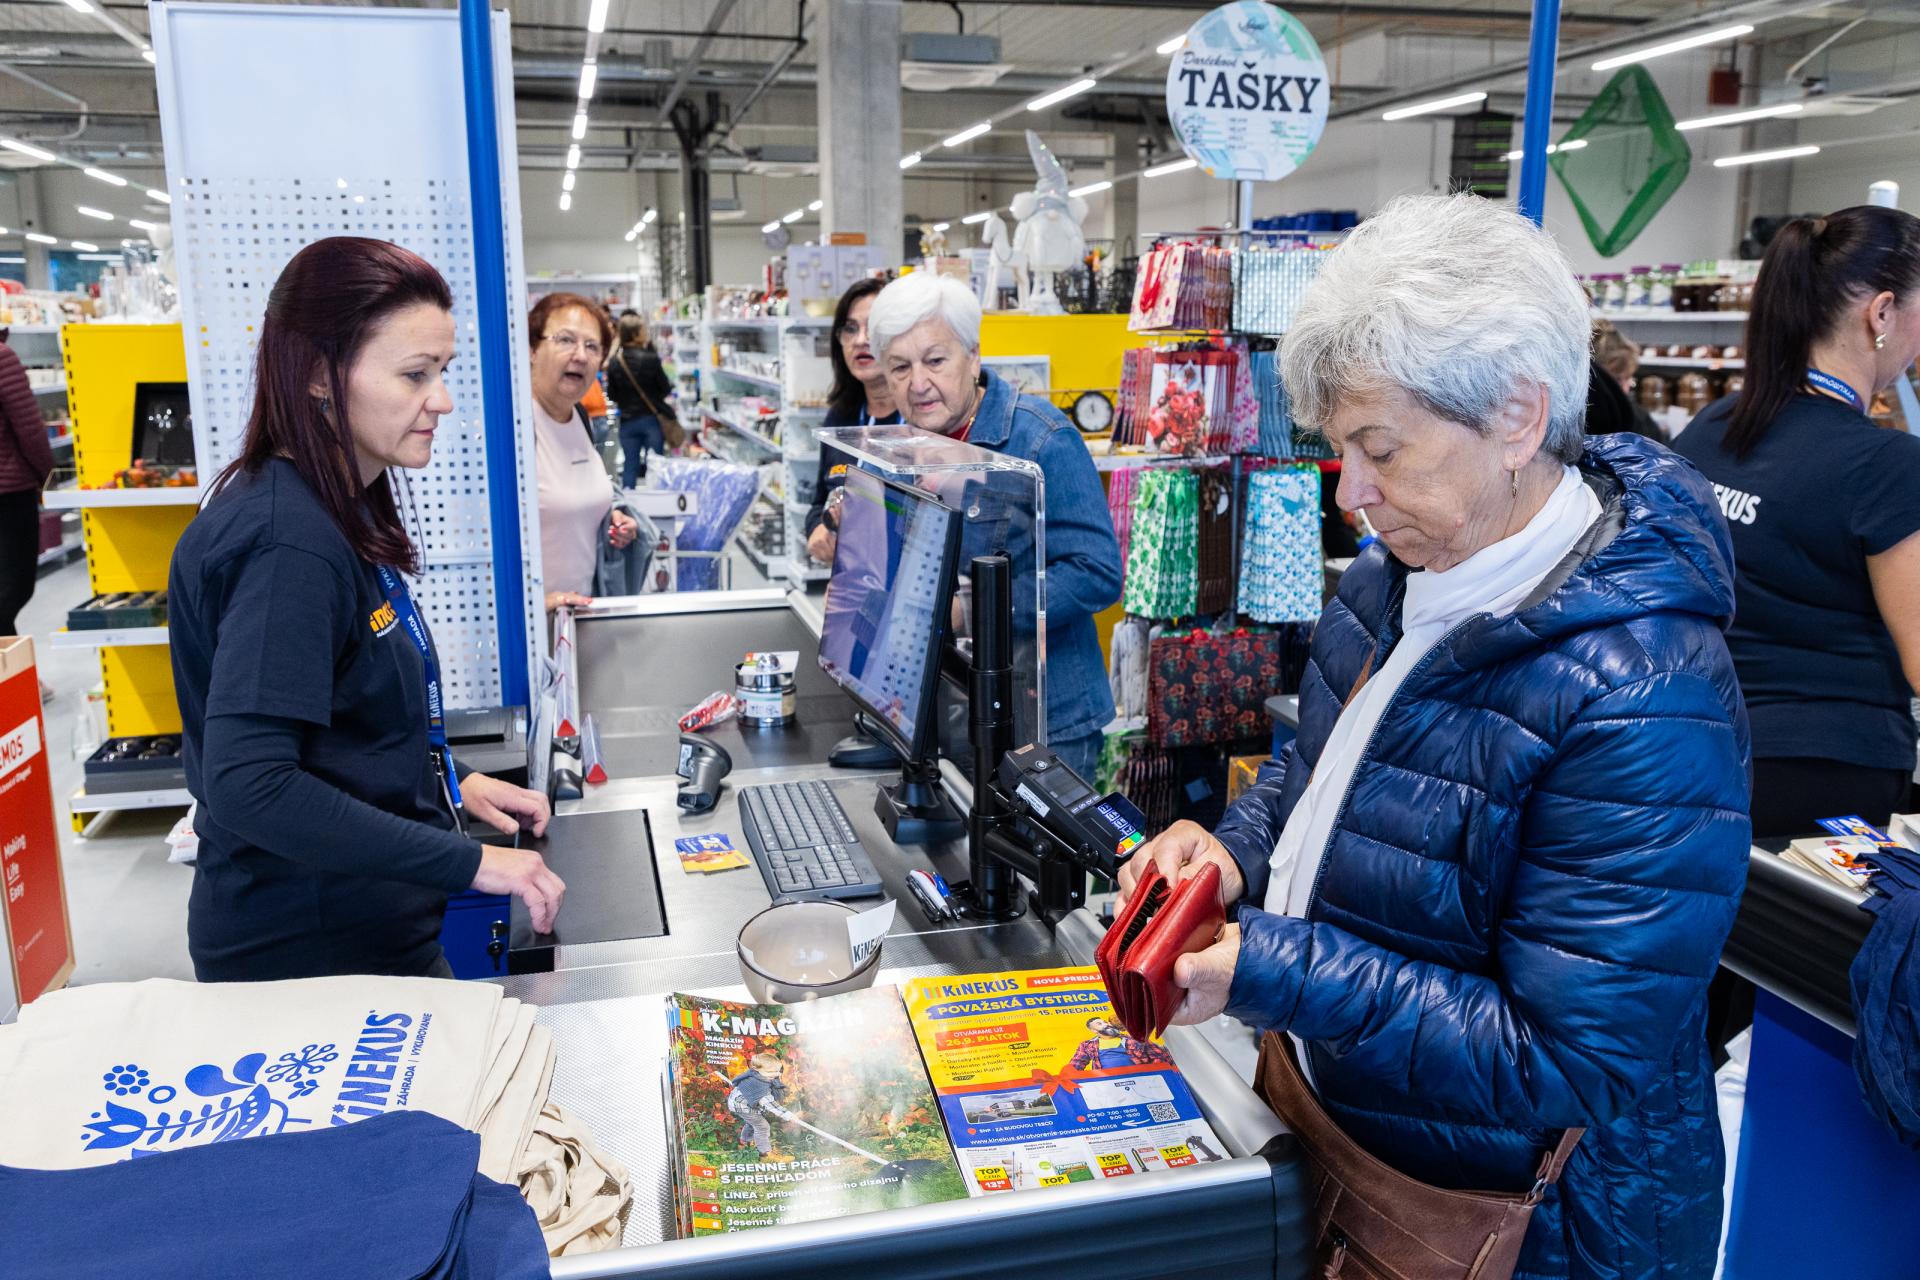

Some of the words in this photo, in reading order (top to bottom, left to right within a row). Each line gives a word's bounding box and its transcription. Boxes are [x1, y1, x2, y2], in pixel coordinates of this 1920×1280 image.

[1180, 61, 1321, 113] TAŠKY
[0, 735, 24, 770] MOS
[944, 978, 1019, 997] KiNEKUS
[1033, 977, 1062, 985] NOVÁ
[1063, 974, 1103, 982] PREDAJ
[938, 996, 1021, 1016] POVAŽSKÁ
[1025, 993, 1100, 1006] BYSTRICA
[1055, 1005, 1110, 1015] PREDAJNE
[411, 1013, 432, 1056] VYKUROVANIE
[946, 1036, 975, 1047] 26.9.
[977, 1031, 1021, 1042] PIATOK
[397, 1065, 416, 1106] ZÁHRADA
[1100, 1154, 1121, 1162] TOP
[1163, 1146, 1184, 1154] TOP
[702, 1169, 713, 1177] 12
[791, 1157, 841, 1171] PRÁCE
[721, 1174, 731, 1184] S
[734, 1169, 831, 1184] PREHĽADOM
[1043, 1176, 1064, 1184] TOP
[725, 1205, 748, 1214] Ako
